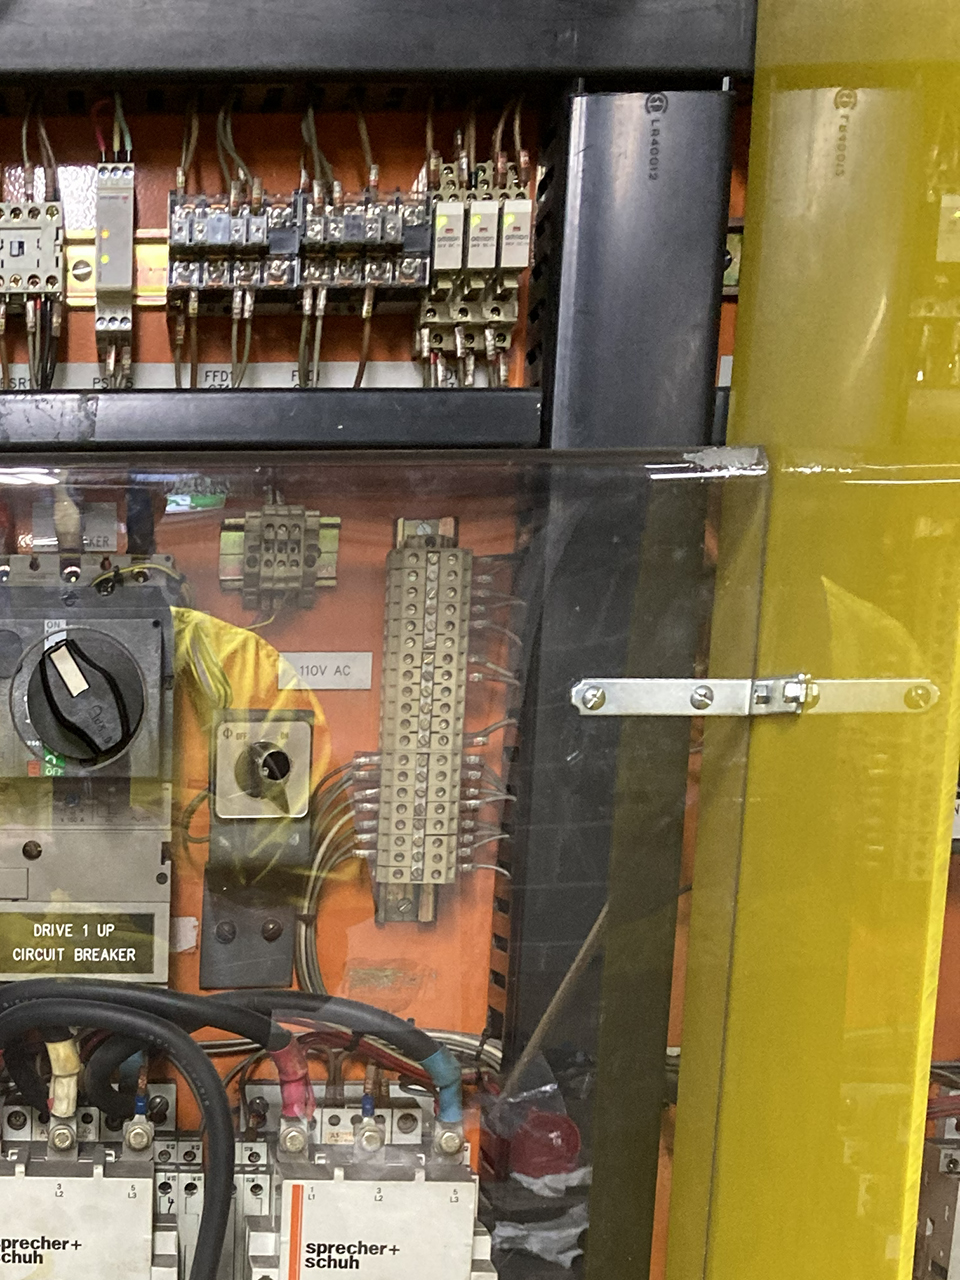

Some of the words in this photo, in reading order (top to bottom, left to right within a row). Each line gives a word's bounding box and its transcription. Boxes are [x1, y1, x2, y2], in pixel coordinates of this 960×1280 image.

[300, 664, 327, 676] 110V
[334, 664, 351, 676] AC
[34, 924, 74, 937] DRIVE
[82, 924, 88, 937] 1
[96, 924, 115, 937] UP
[12, 948, 64, 962] CIRCUIT
[74, 948, 136, 962] BREAKER
[55, 1190, 64, 1198] L2
[130, 1184, 136, 1192] 5
[453, 1188, 458, 1196] 5
[305, 1240, 400, 1257] sprecher+
[305, 1254, 360, 1270] schuh
